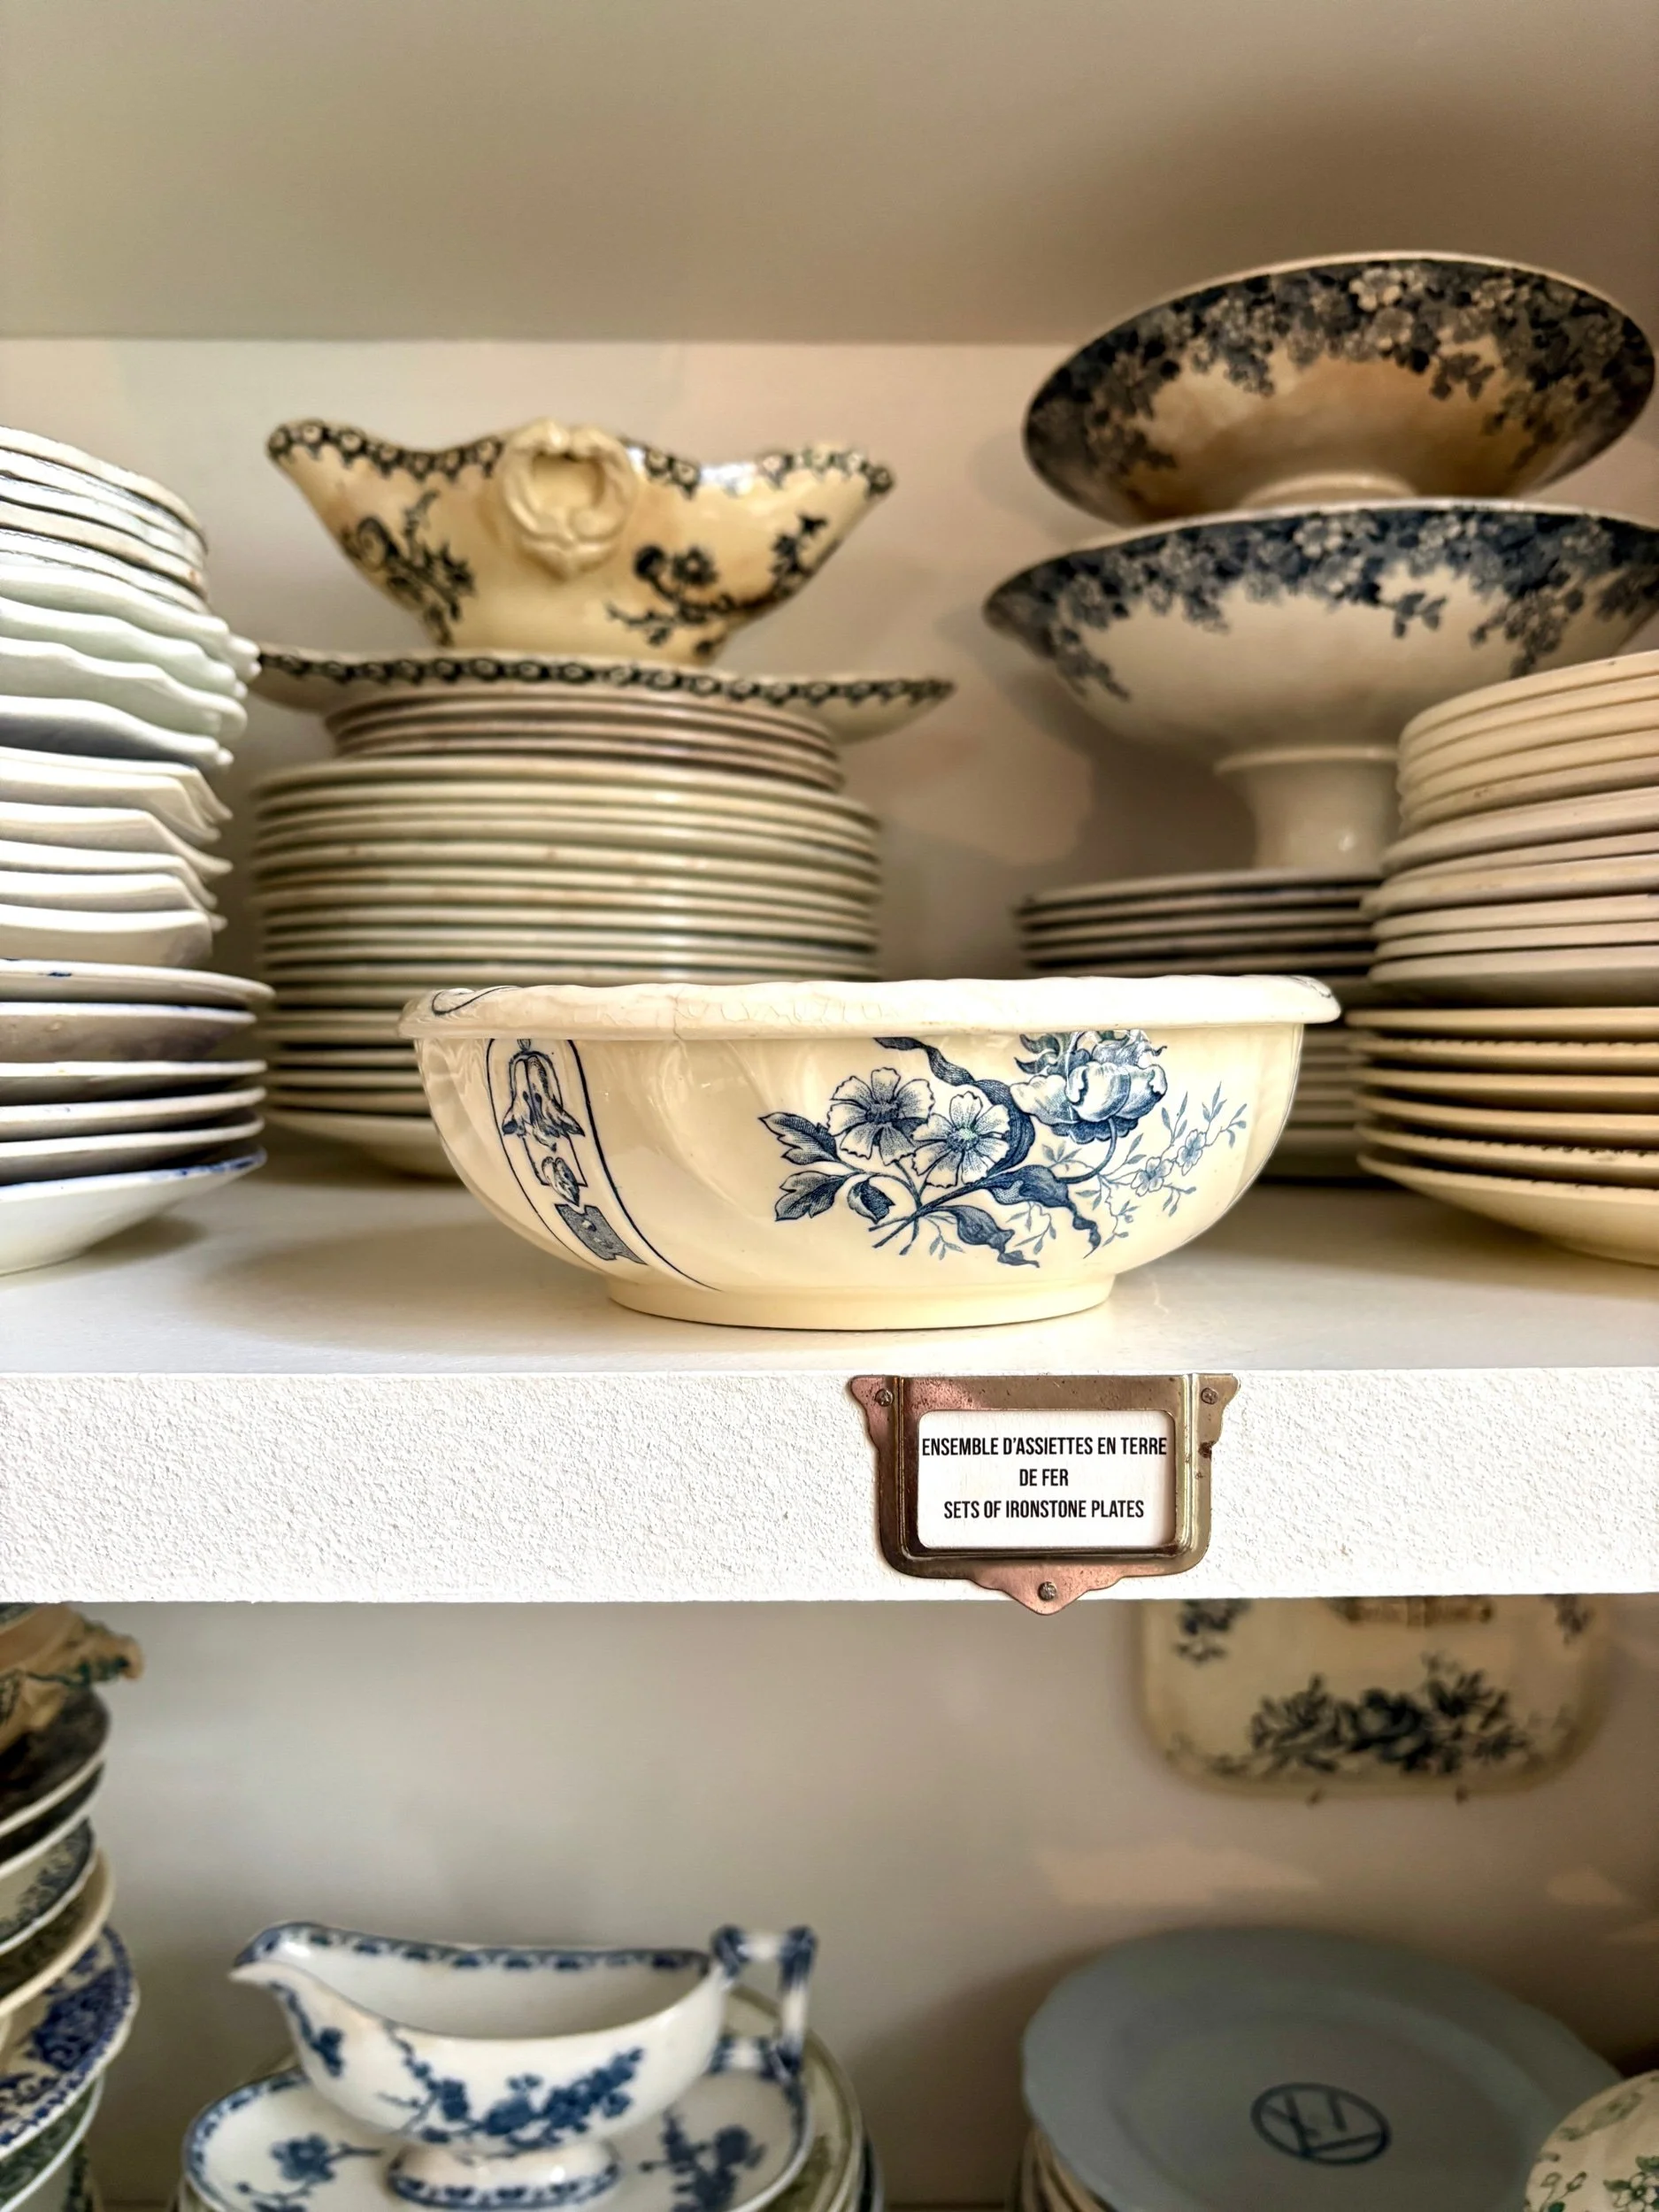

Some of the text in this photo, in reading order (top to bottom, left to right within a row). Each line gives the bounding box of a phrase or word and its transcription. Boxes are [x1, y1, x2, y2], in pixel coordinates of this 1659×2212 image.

[922, 1436, 1168, 1456] ENSEMBLE D'ASSIETTES EN TERRE
[1019, 1468, 1069, 1486] DE FER
[943, 1500, 1145, 1519] SETS OF IRONSTONE PLATES
